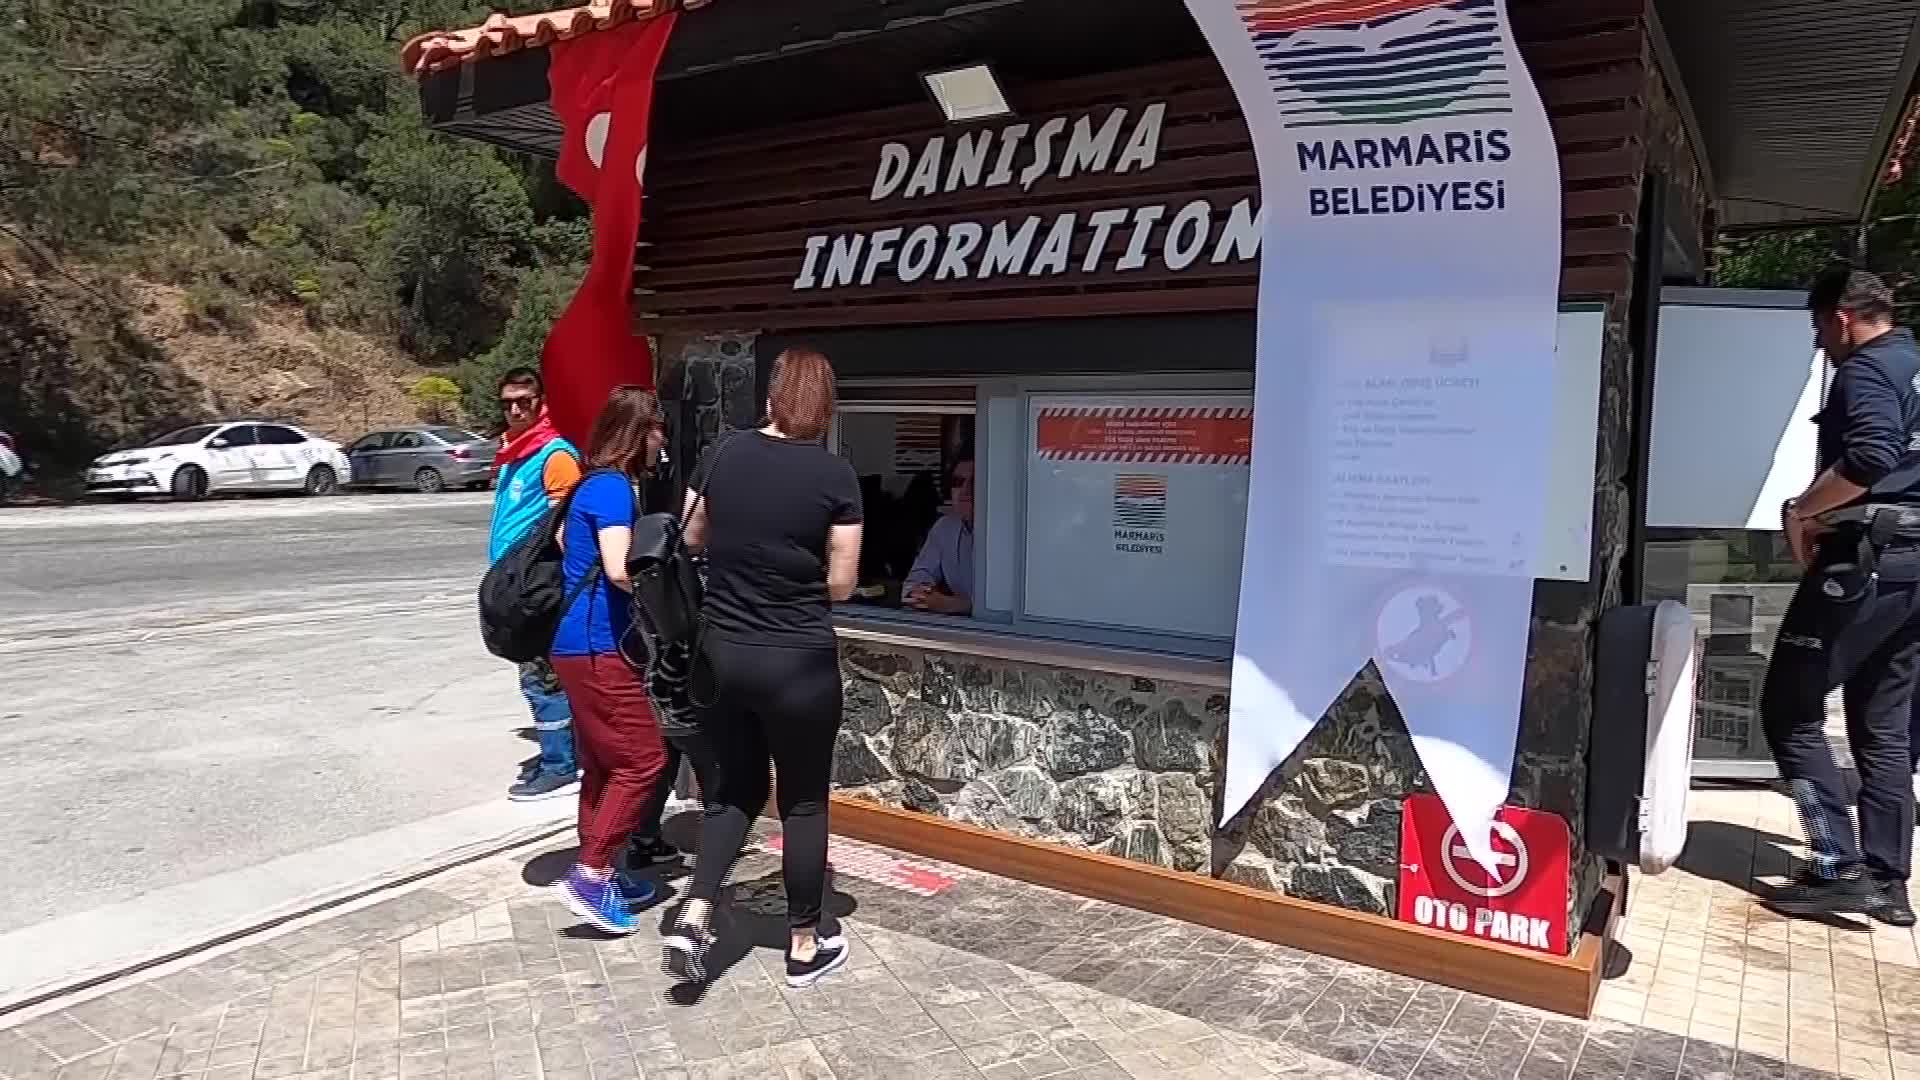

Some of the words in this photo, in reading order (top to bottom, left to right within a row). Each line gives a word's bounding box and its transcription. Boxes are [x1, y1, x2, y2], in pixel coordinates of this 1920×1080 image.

[870, 103, 1167, 201] DANIŞMA
[793, 197, 1264, 290] INFORMATION
[1414, 895, 1469, 932] OTO
[1474, 907, 1550, 949] PARK
